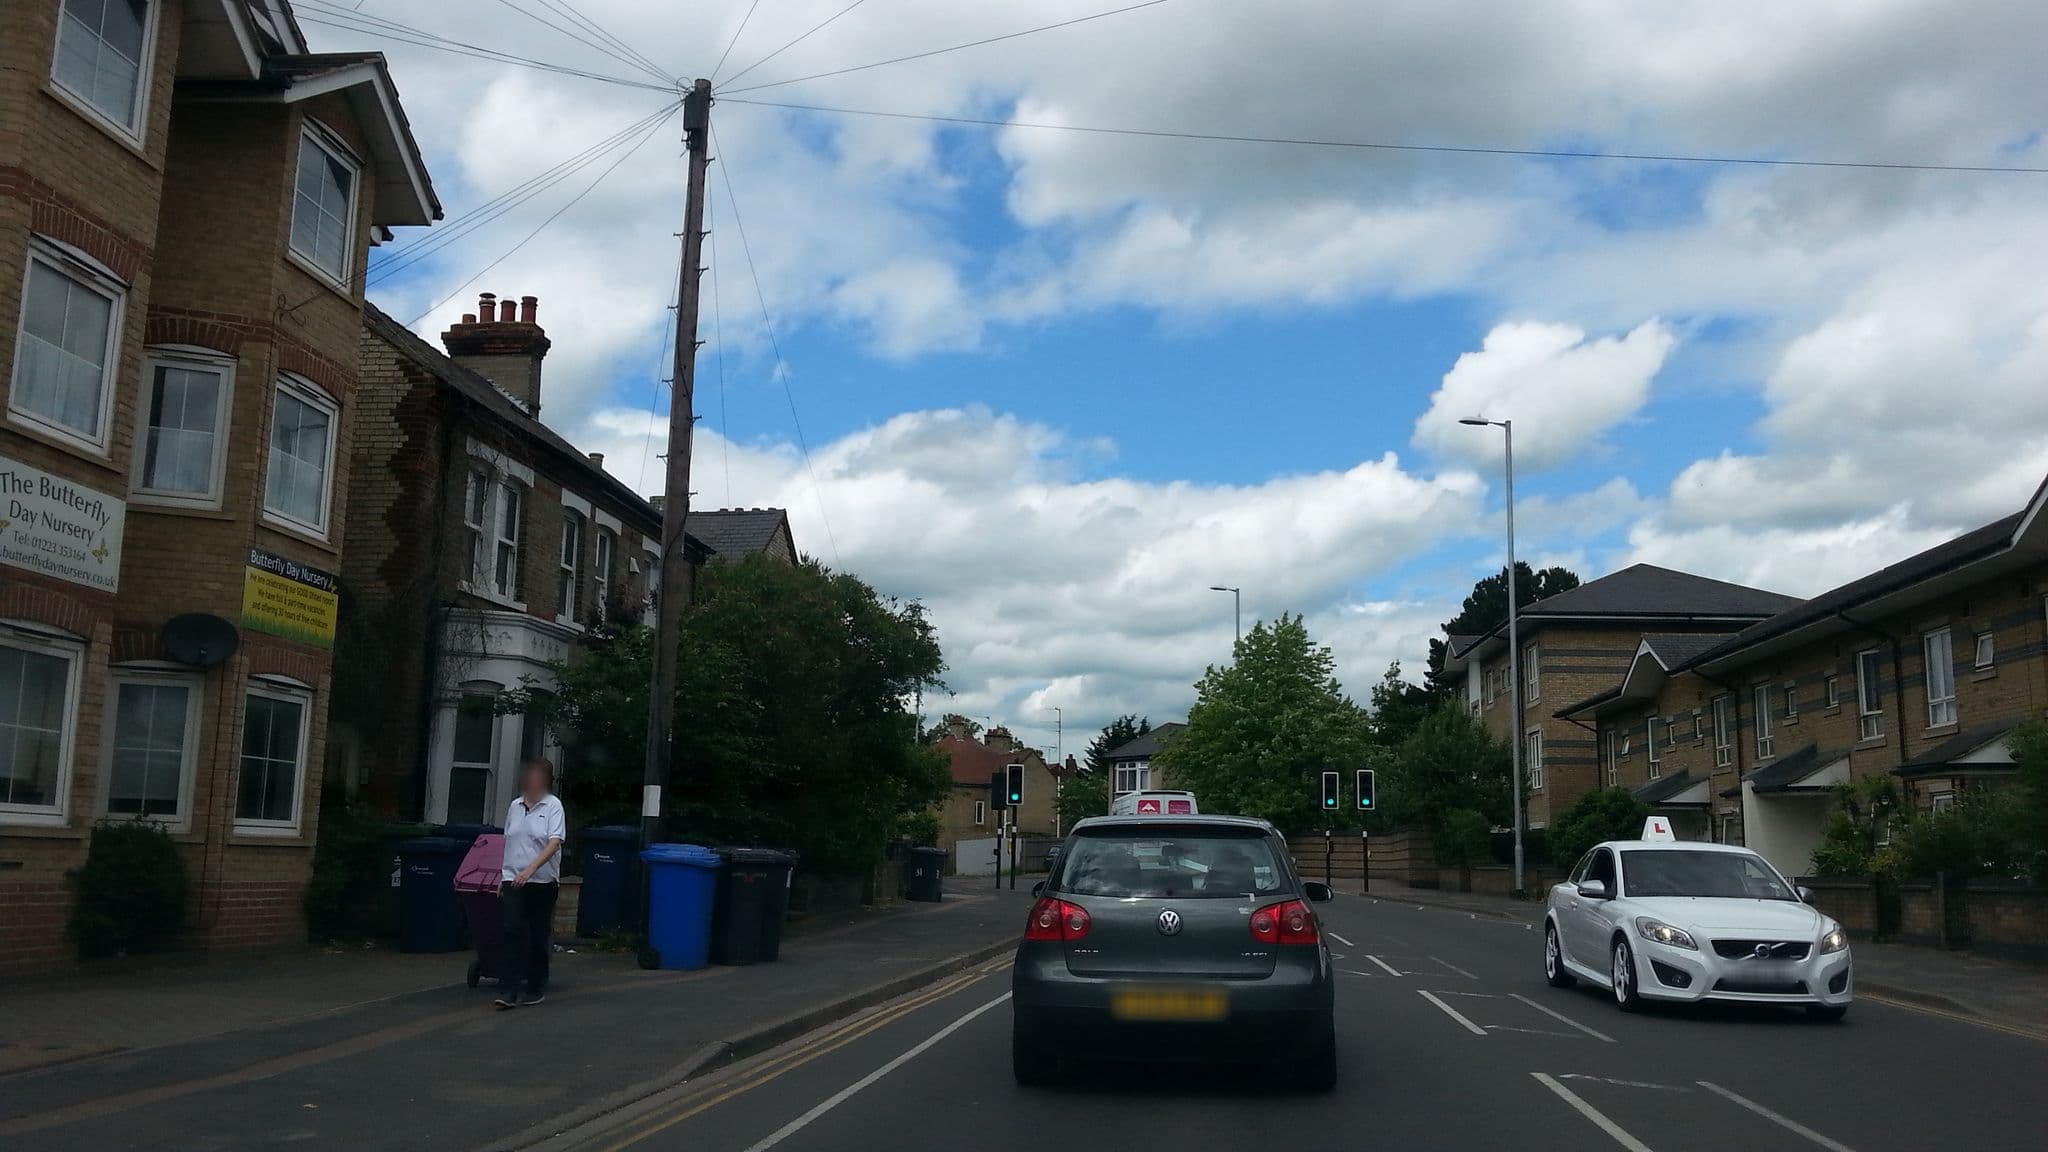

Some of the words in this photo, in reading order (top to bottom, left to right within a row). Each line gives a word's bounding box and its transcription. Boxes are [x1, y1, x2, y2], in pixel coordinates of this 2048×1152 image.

[0, 471, 33, 494] The
[39, 476, 110, 531] Butterfly
[9, 500, 38, 530] Day
[41, 510, 95, 547] Nursery
[13, 530, 30, 545] Tel:
[31, 537, 57, 553] 01223
[59, 545, 86, 563] 353164
[250, 550, 285, 575] Butterfly
[286, 561, 301, 580] Day
[301, 568, 329, 590] Nursery
[1654, 822, 1666, 834] L
